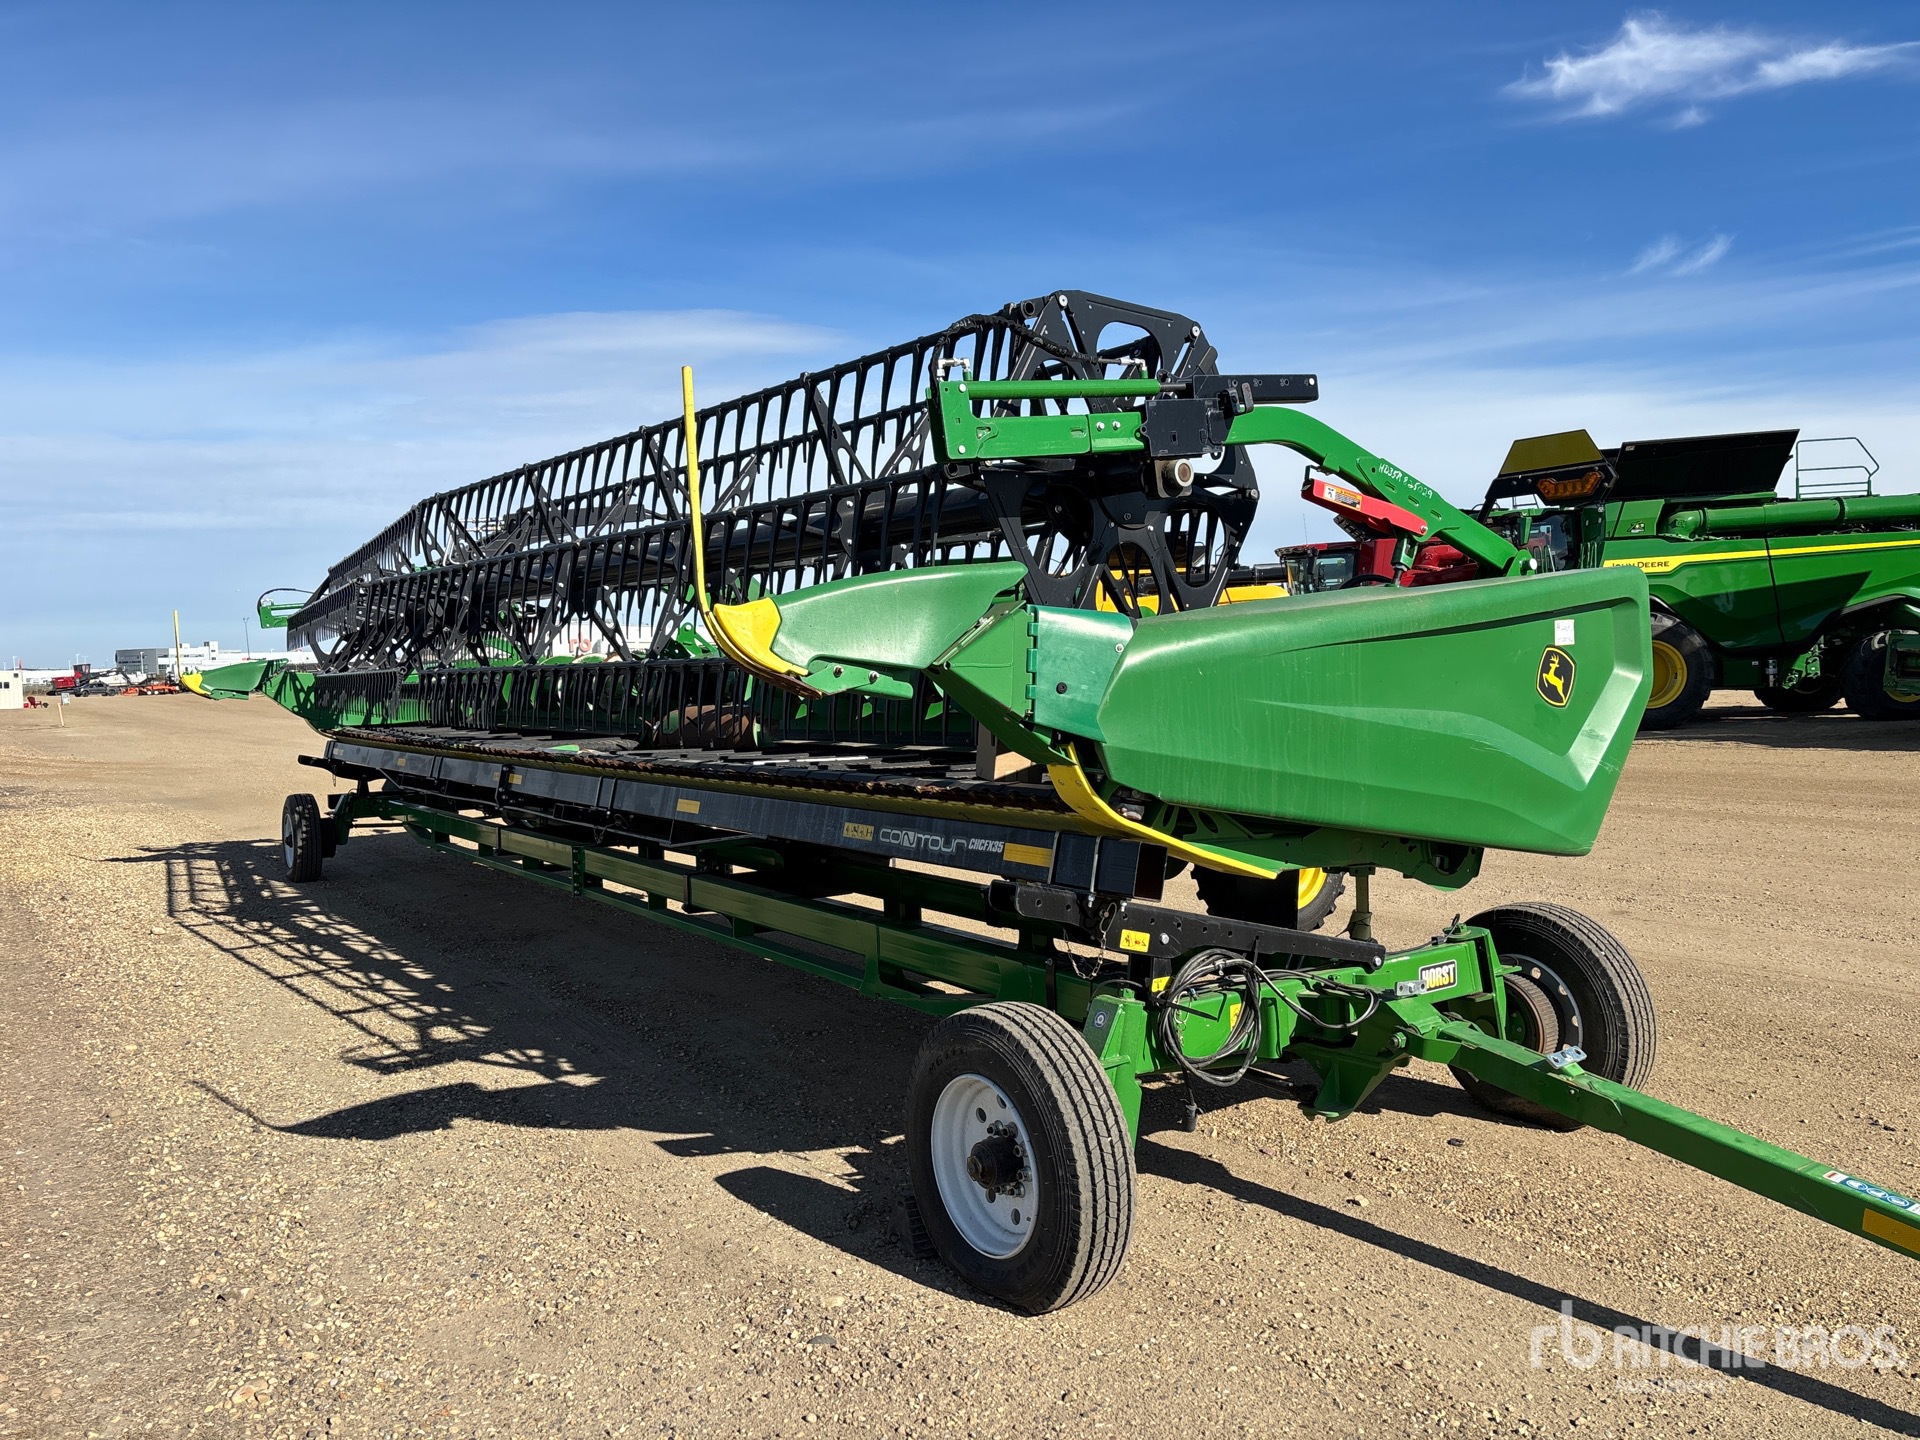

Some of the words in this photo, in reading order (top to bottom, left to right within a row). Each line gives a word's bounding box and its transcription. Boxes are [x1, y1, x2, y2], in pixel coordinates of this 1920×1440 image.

[1637, 561, 1670, 569] DEERE
[968, 838, 1004, 853] CHCFX35
[1422, 963, 1455, 989] HORST
